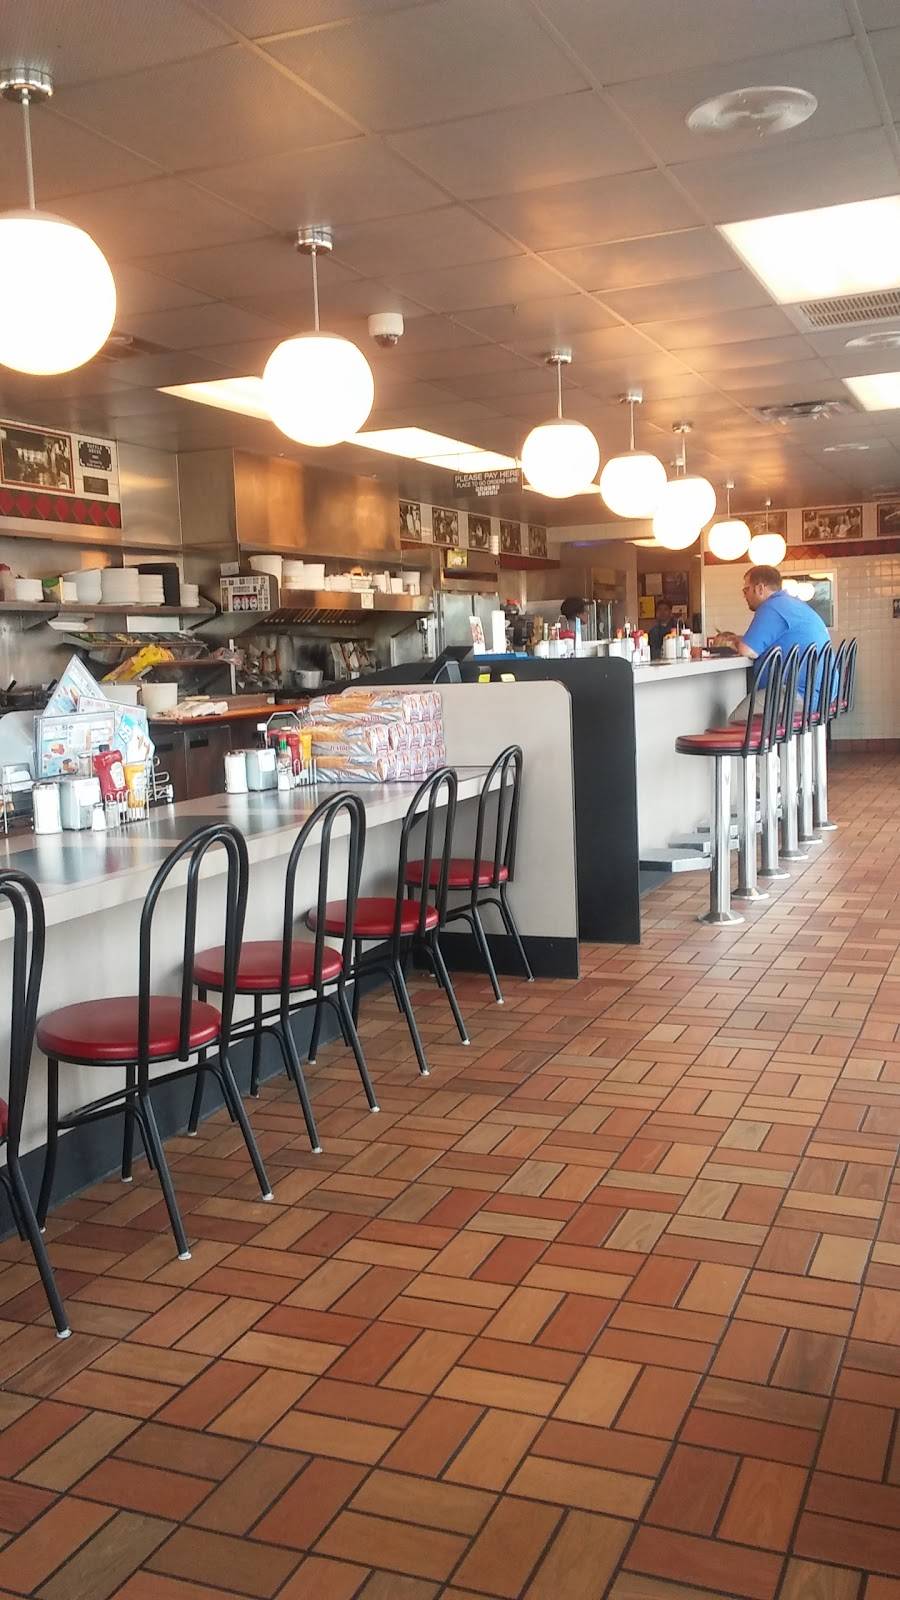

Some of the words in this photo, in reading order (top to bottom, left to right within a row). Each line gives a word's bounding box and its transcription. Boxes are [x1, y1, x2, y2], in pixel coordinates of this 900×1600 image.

[455, 473, 482, 482] PLEASE
[484, 471, 499, 479] PAY
[500, 470, 520, 478] HERE
